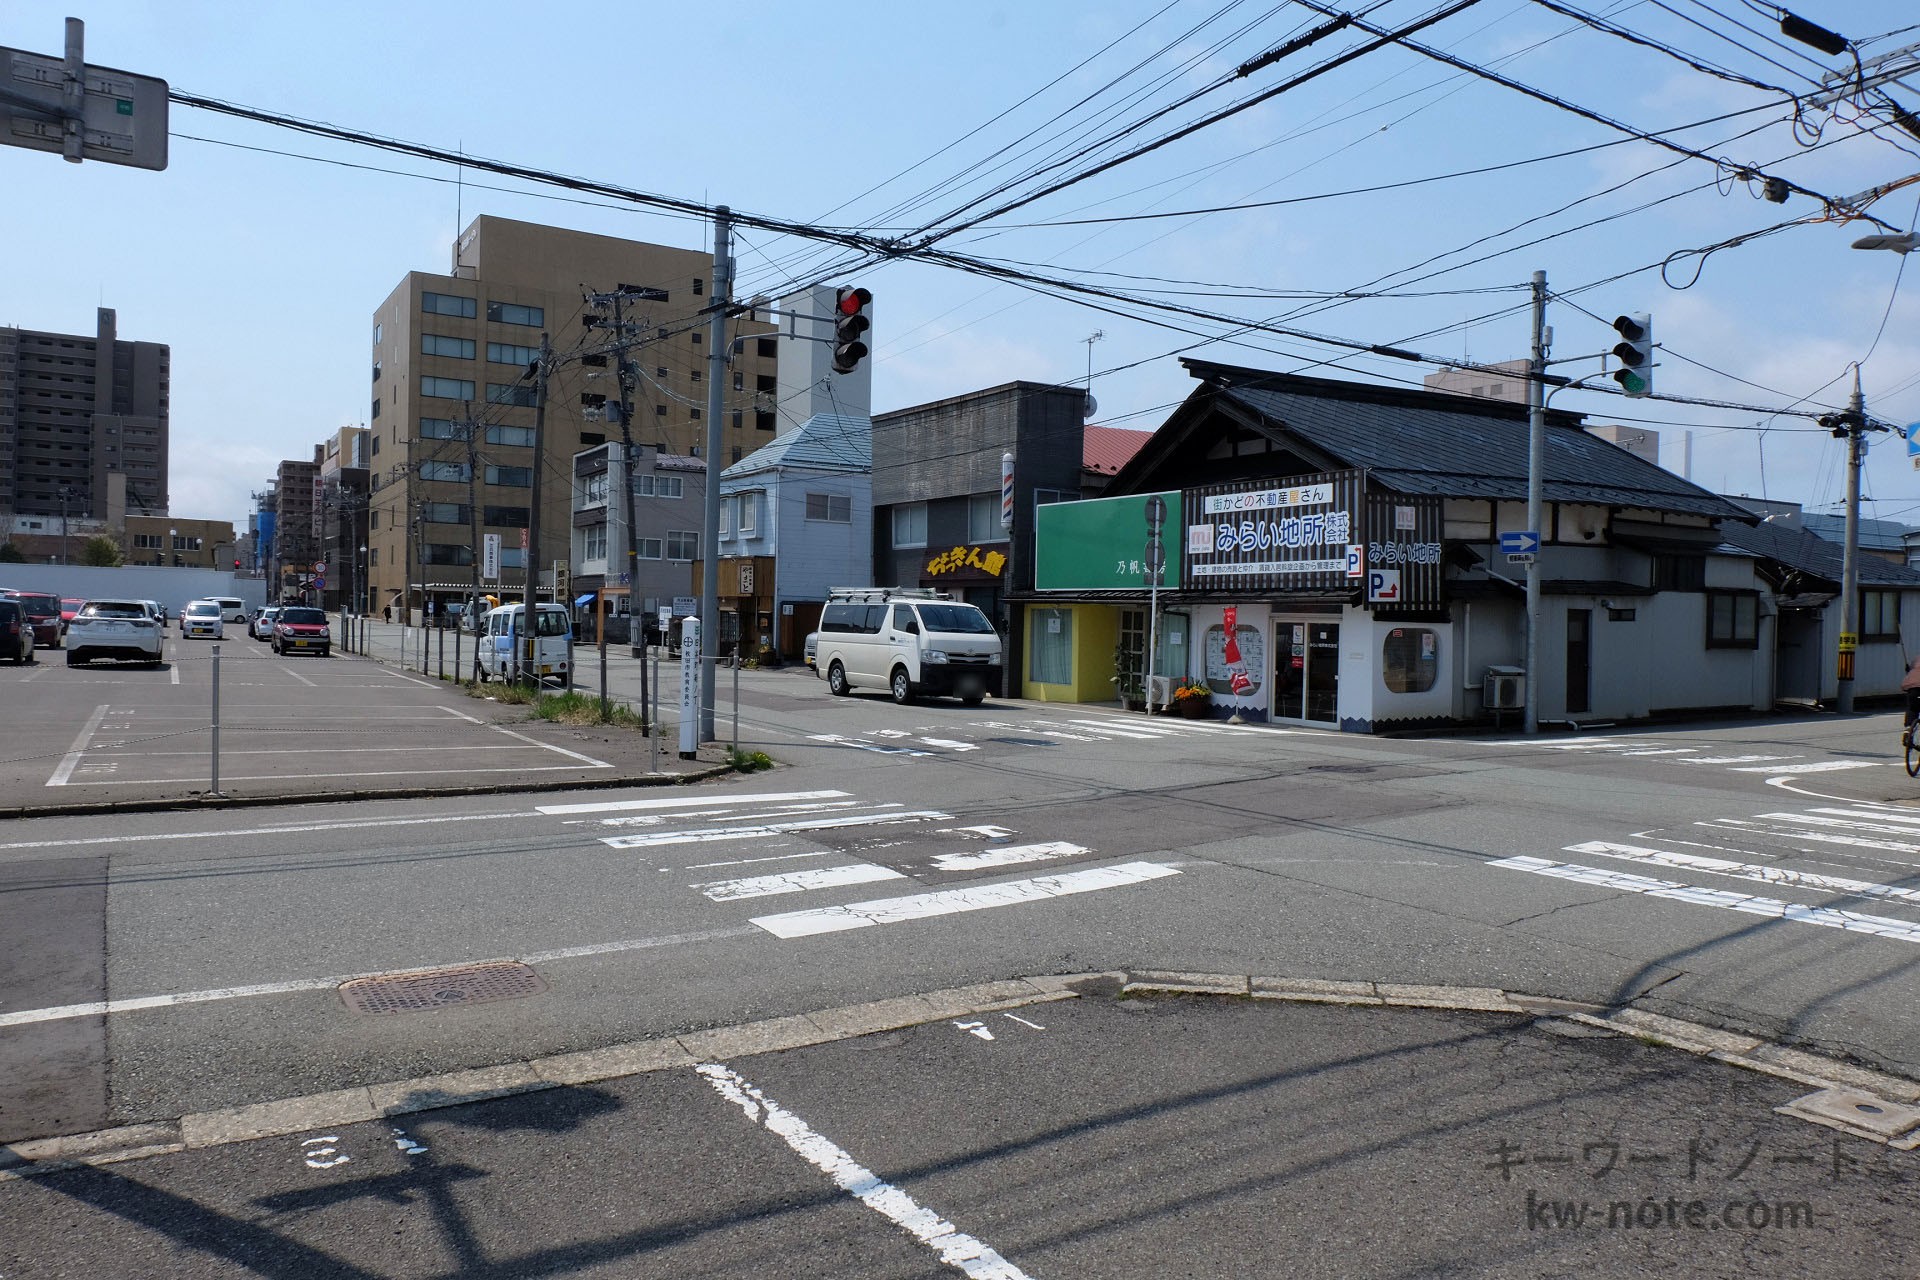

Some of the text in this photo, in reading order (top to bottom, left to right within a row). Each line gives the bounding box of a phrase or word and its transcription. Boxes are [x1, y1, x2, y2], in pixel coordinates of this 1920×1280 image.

[1213, 488, 1324, 511] 街かどの不動産屋さん
[1217, 515, 1324, 551] みらい地所
[1326, 514, 1349, 529] 株式
[1326, 528, 1349, 543] 会社
[926, 545, 1008, 577] ちょっきん館
[1348, 553, 1358, 571] P
[1368, 541, 1442, 564] みらい地所
[1370, 573, 1384, 598] P
